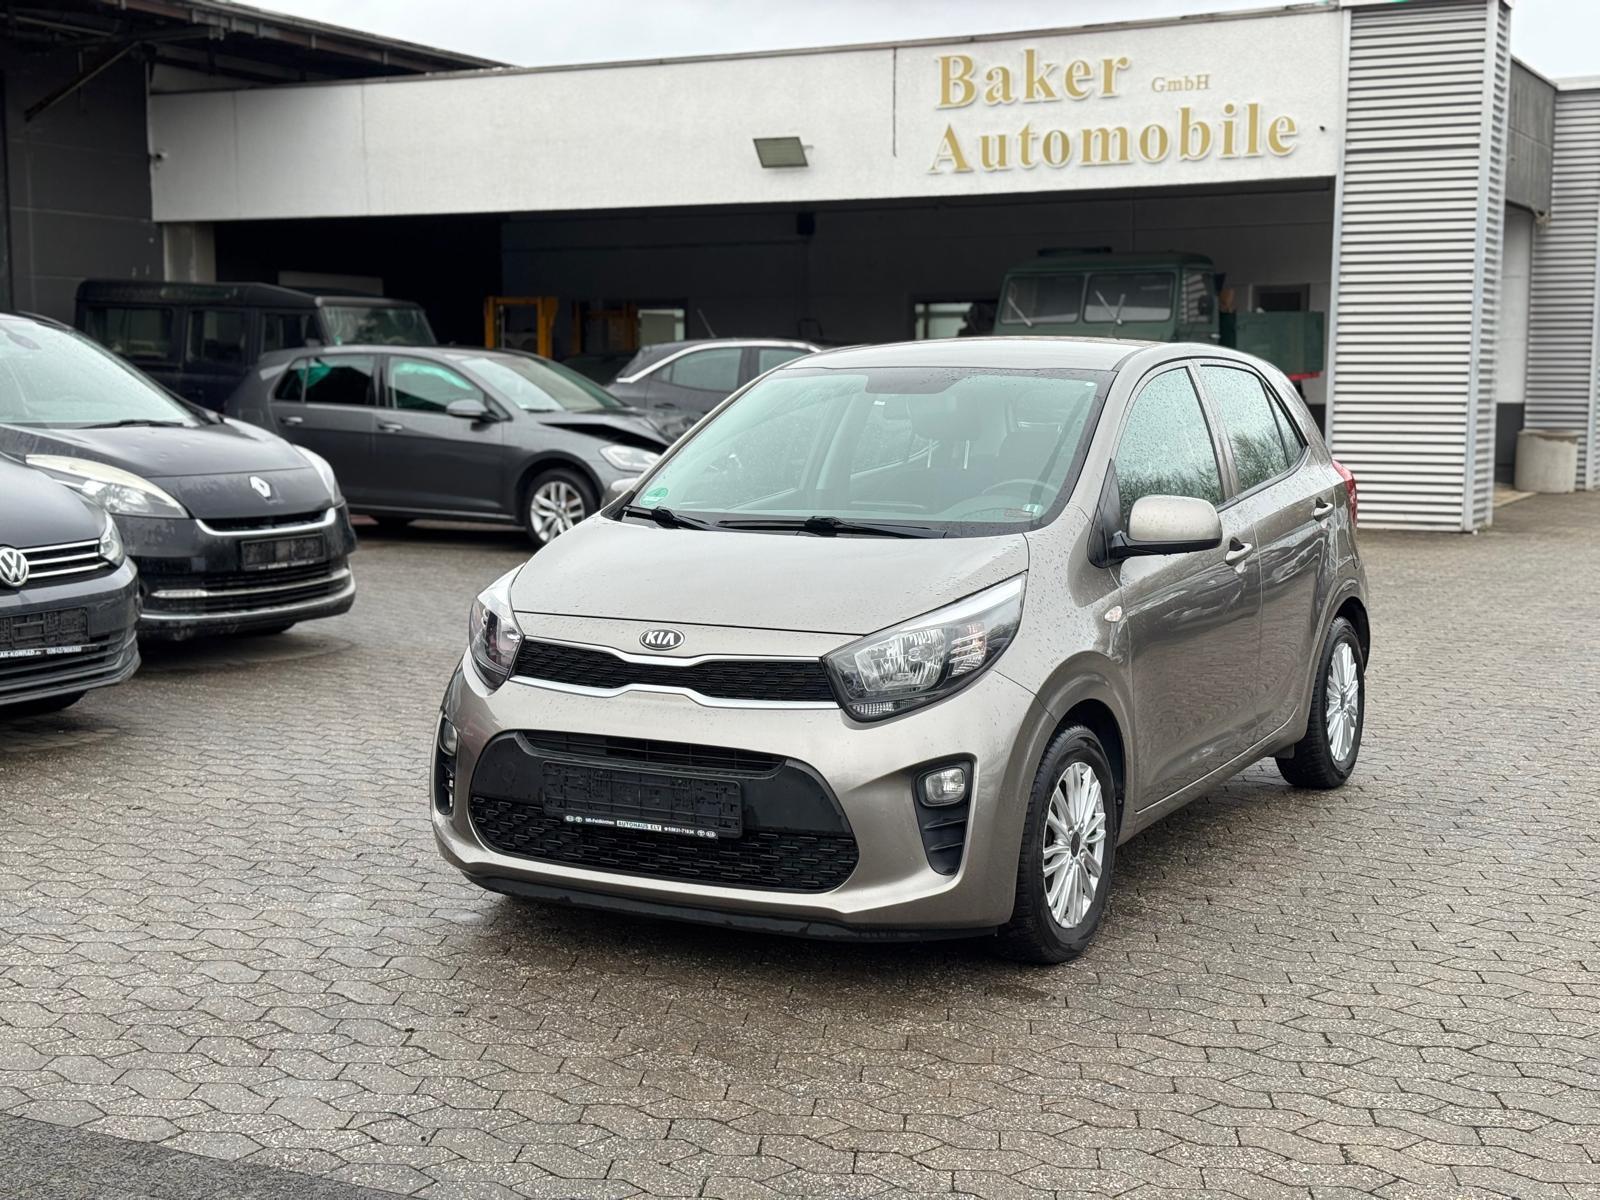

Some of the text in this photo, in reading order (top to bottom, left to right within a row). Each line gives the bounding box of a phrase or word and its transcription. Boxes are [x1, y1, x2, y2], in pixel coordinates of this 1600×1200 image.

[935, 48, 1211, 109] Baker GmbH
[927, 102, 1299, 174] Automobile
[645, 631, 675, 646] KIA
[617, 820, 649, 829] AUTOHAUS
